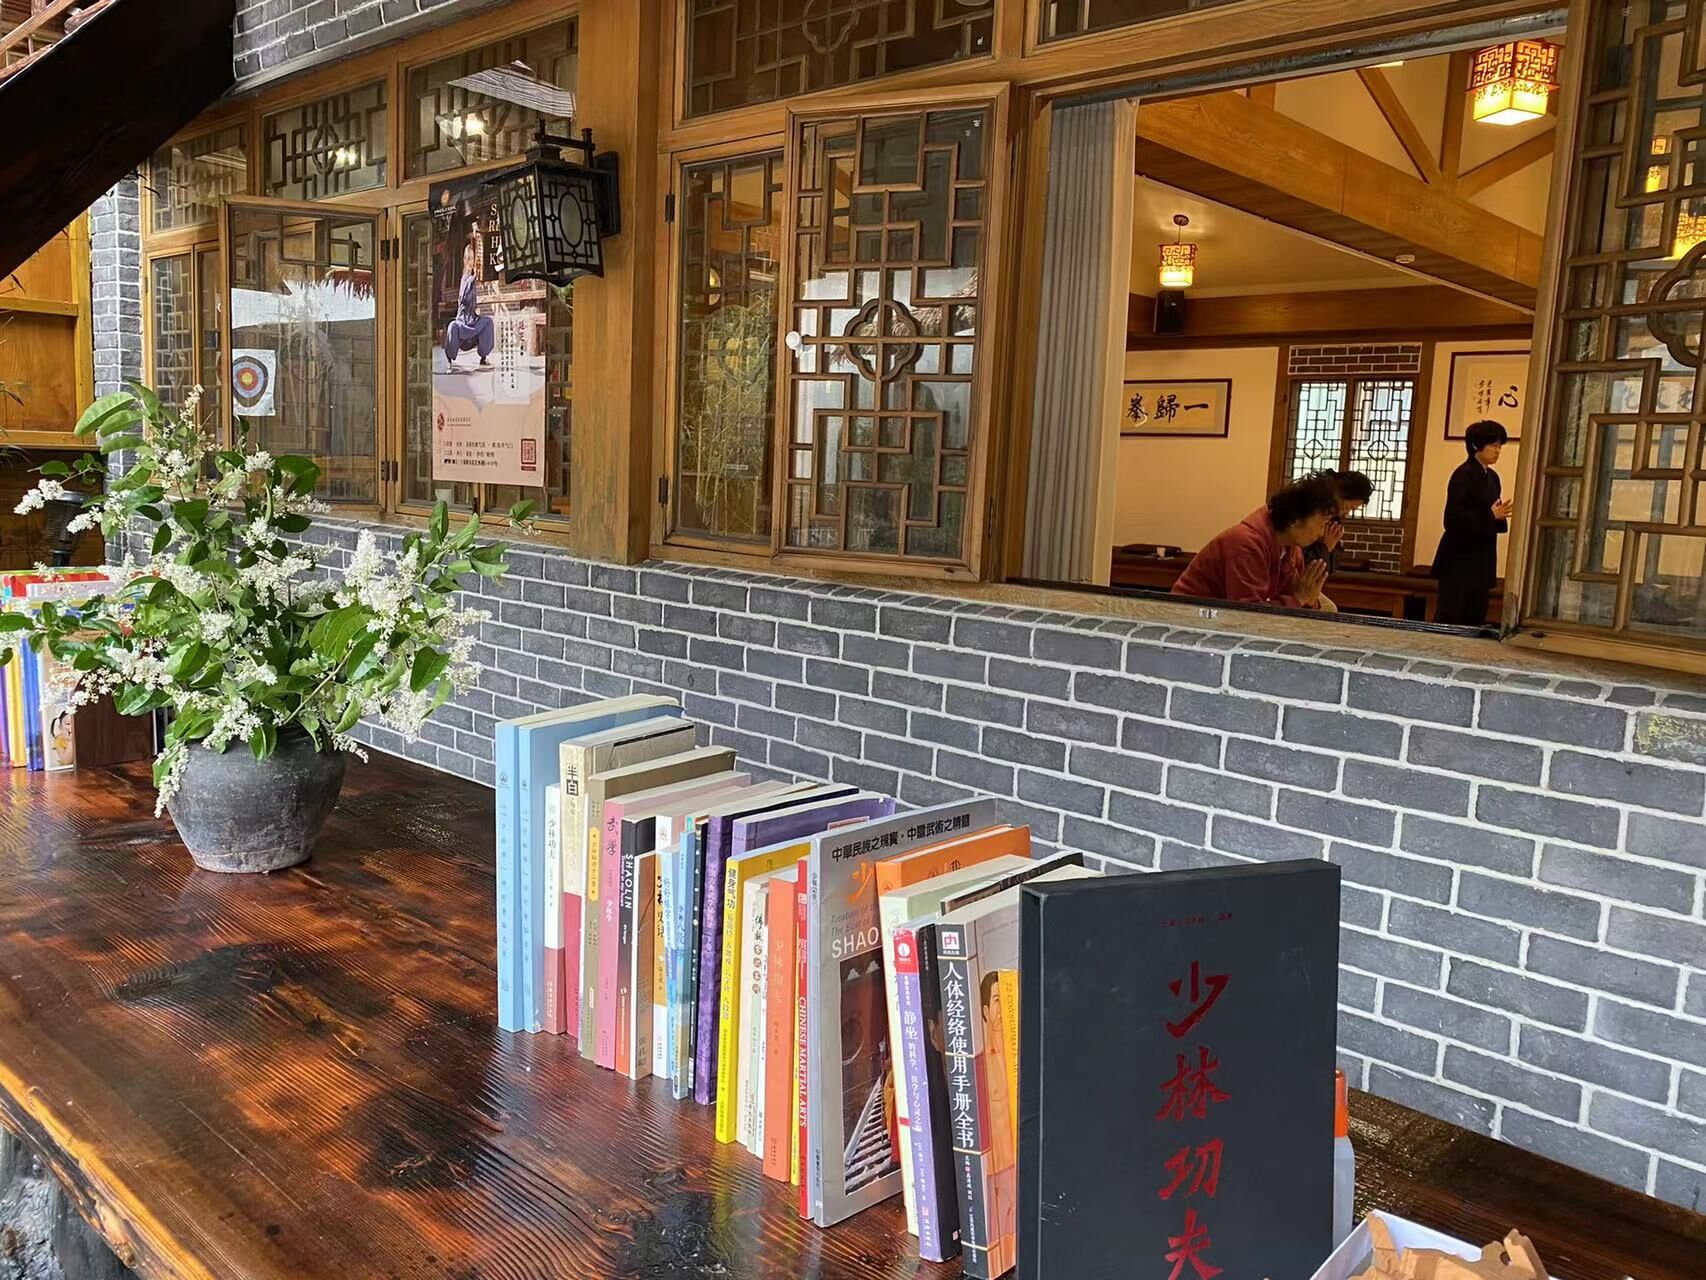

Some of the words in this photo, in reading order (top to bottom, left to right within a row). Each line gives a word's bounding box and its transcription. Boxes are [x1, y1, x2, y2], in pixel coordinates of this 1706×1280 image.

[1497, 385, 1519, 408] 心
[624, 853, 634, 909] SHAOLIN
[799, 996, 808, 1045] CHINESE
[799, 1046, 808, 1097] MARTIAL
[943, 961, 975, 1149] 人体经络使用手册全书
[799, 1098, 808, 1128] ARTS
[1156, 960, 1233, 1280] 少林功夫
